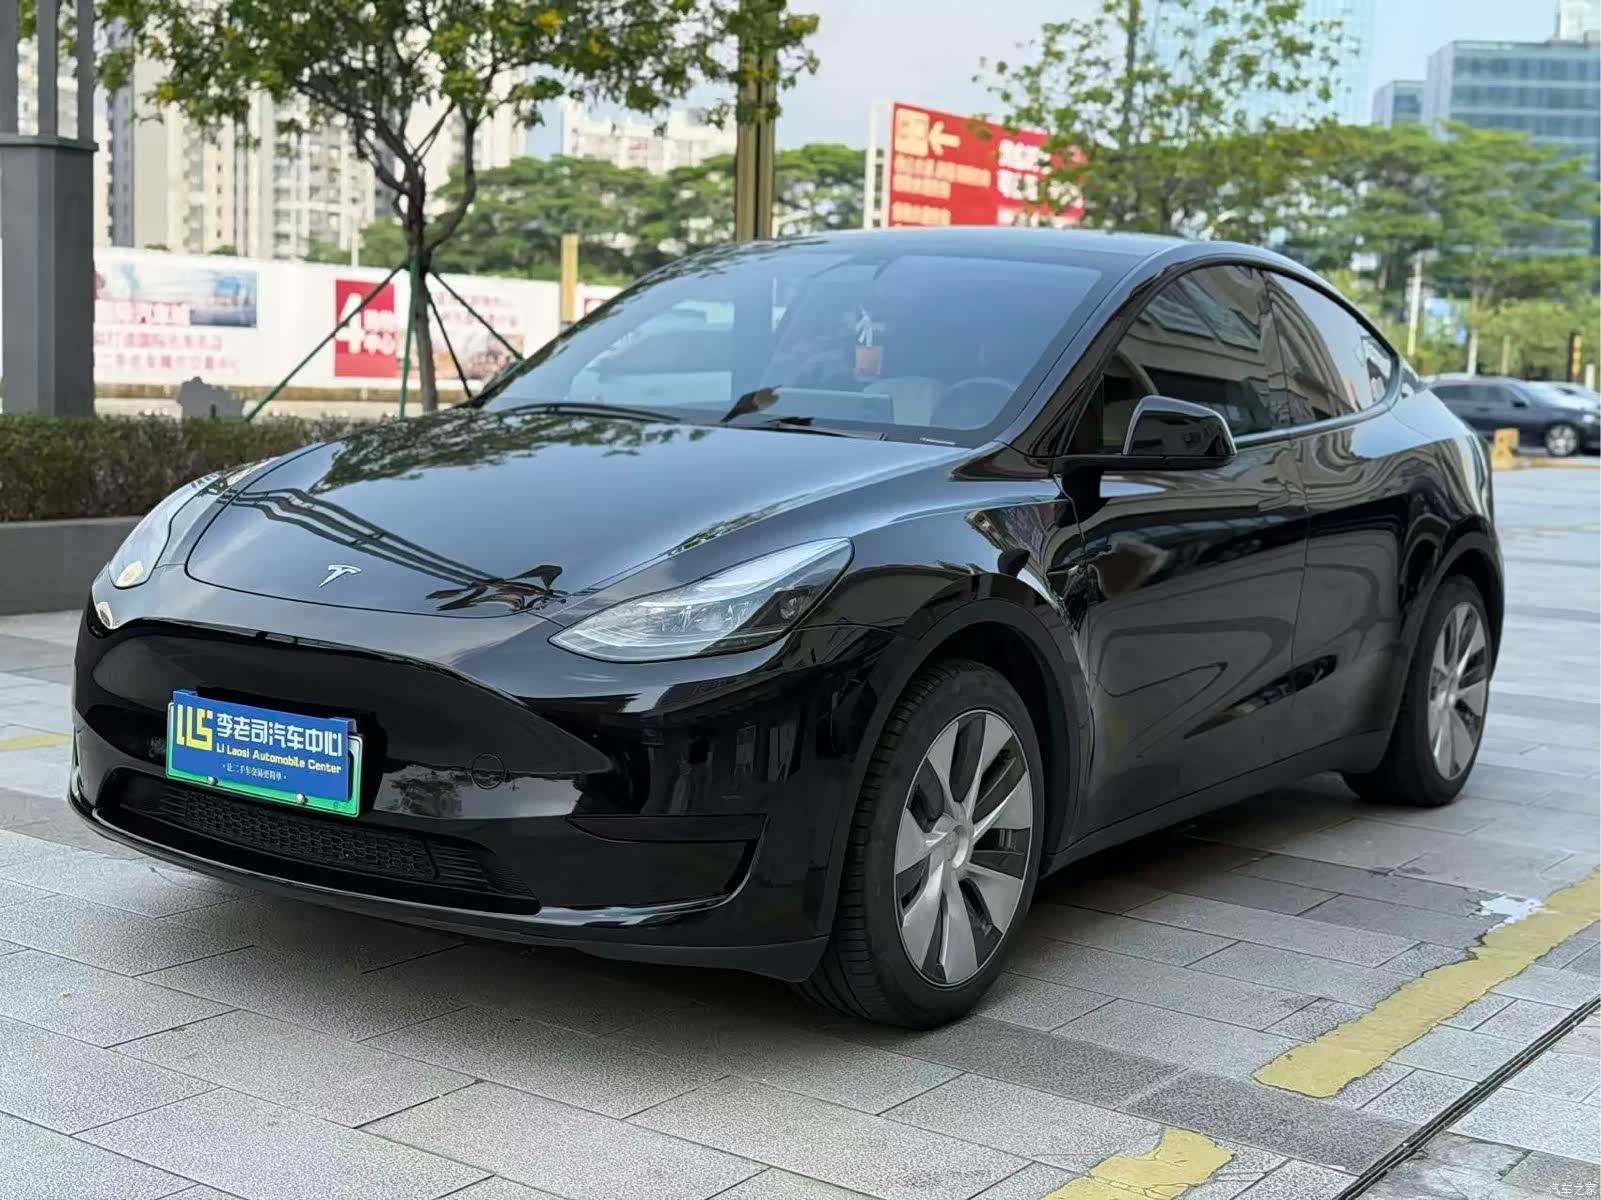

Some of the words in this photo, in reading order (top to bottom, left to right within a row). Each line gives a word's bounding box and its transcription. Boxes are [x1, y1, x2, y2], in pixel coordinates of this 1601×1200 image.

[216, 713, 342, 757] 李老司汽车中心
[226, 744, 250, 758] Laosi
[252, 749, 306, 768] Automobile
[308, 759, 342, 774] Center
